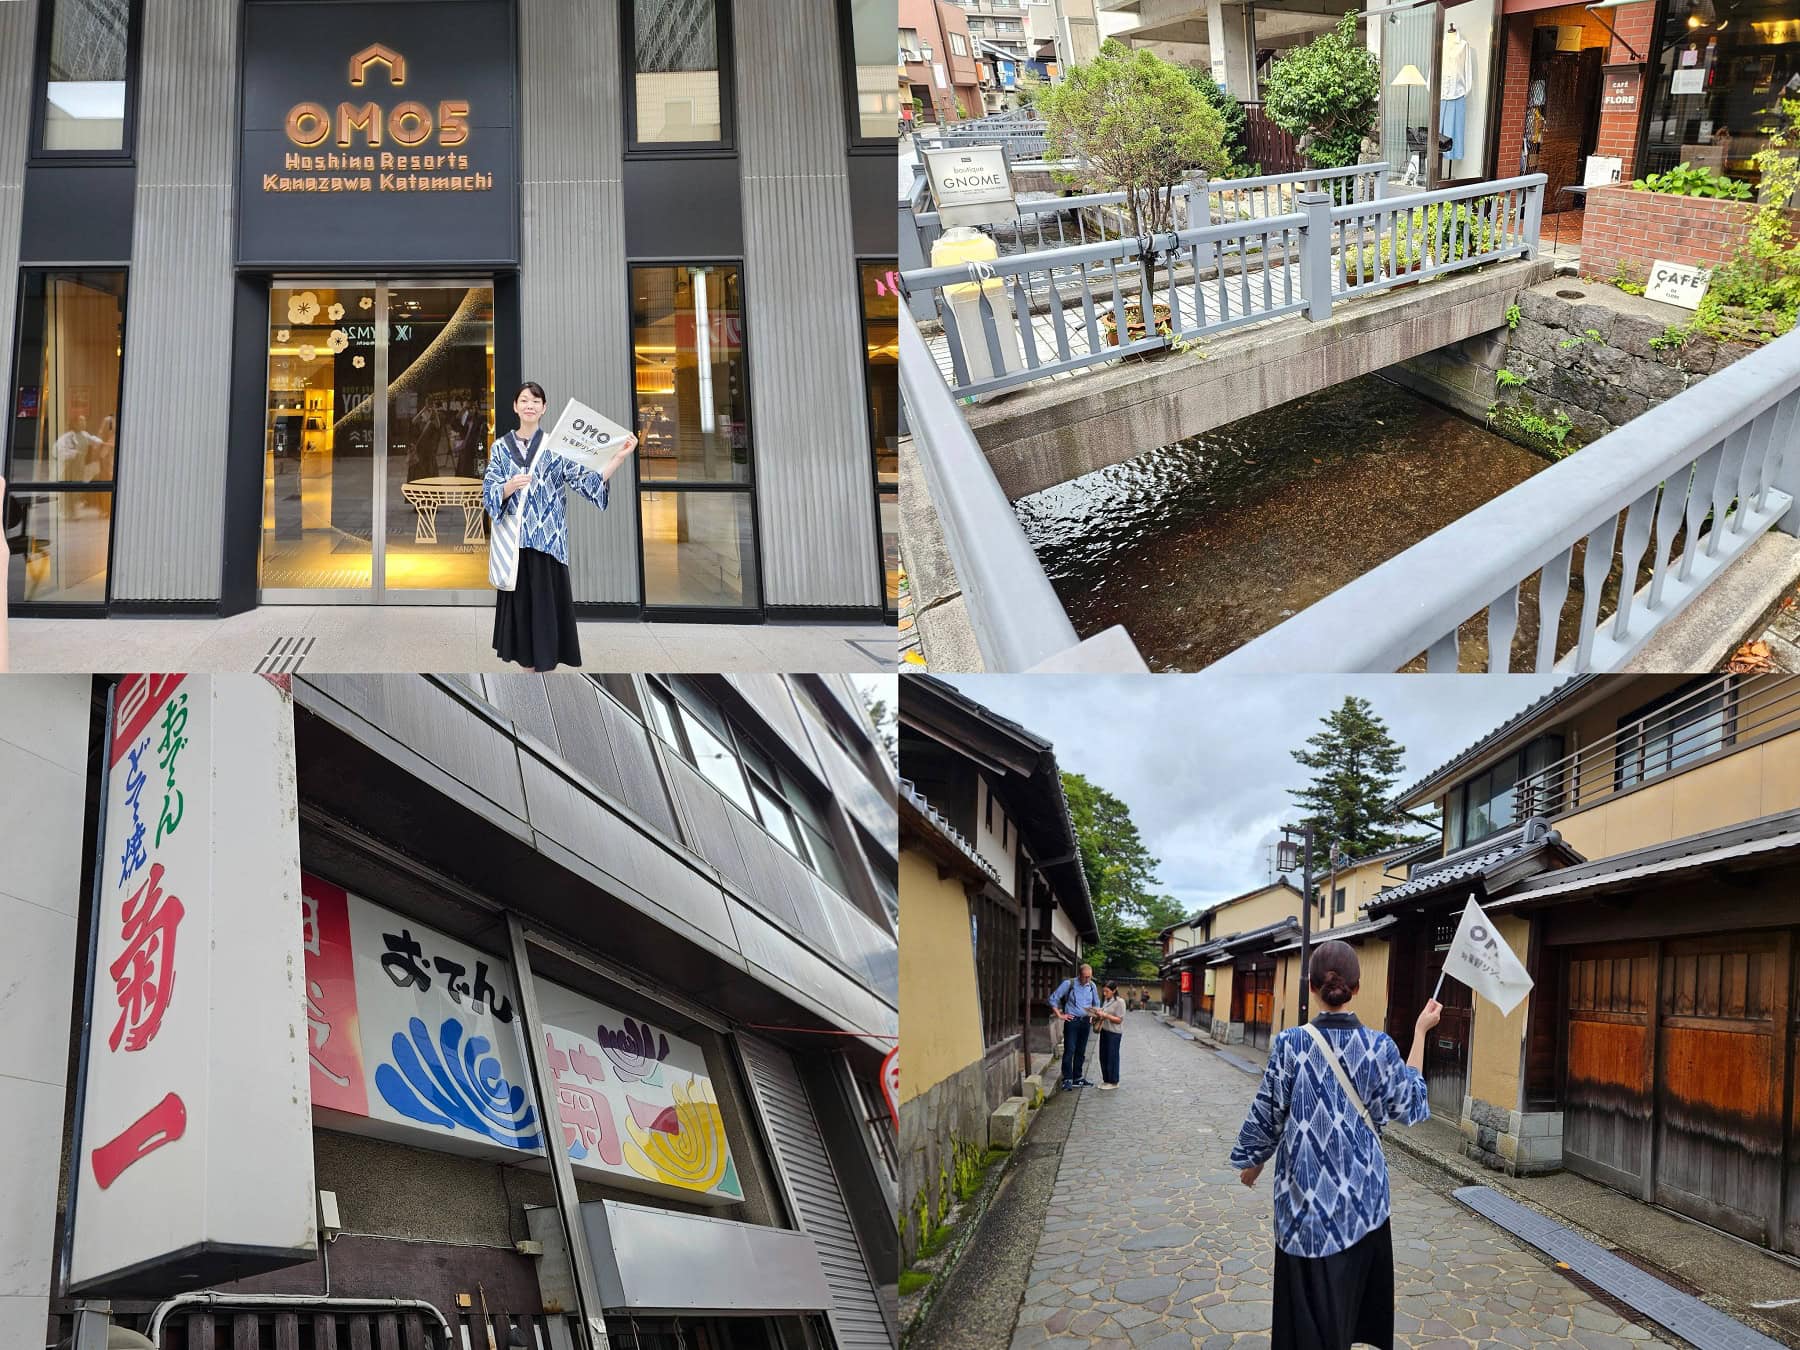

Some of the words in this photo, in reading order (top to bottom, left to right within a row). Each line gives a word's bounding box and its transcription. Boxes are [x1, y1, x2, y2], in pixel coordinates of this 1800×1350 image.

[1605, 96, 1635, 105] FLORE
[286, 101, 470, 147] OMO5
[285, 153, 375, 171] Hoshino
[380, 152, 469, 170] Resorts
[263, 174, 373, 193] Kanazawa
[380, 172, 493, 191] Katamachi
[943, 174, 1000, 189] GNOME
[572, 418, 611, 444] OMO
[157, 693, 188, 849] おでん
[381, 929, 514, 1024] おでん
